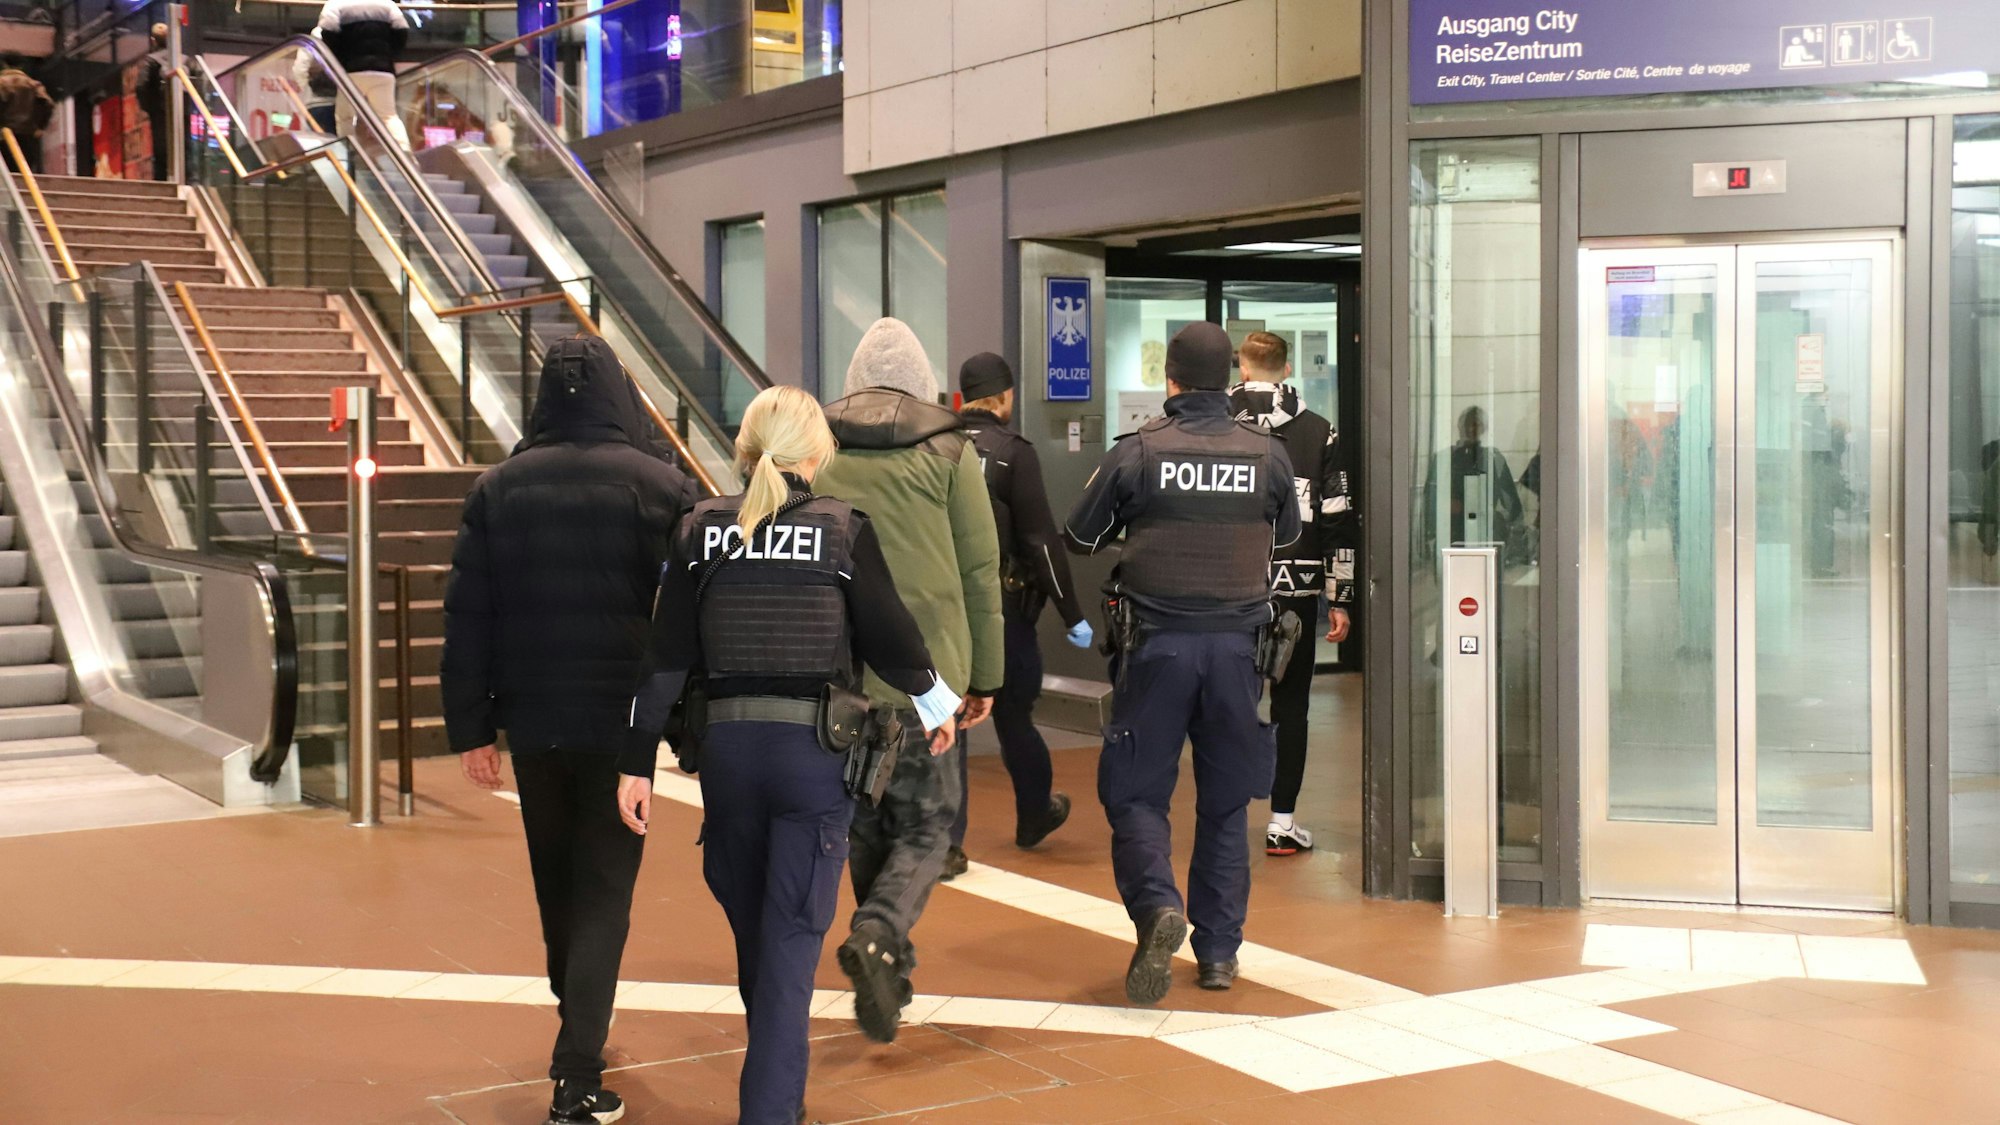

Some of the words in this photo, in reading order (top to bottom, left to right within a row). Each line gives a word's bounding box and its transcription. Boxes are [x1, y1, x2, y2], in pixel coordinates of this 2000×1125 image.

[1437, 14, 1529, 38] Ausgang
[1535, 10, 1578, 33] City
[1436, 40, 1582, 64] ReiseZentrum
[1437, 75, 1459, 87] Exit
[1461, 73, 1486, 88] City,
[1489, 72, 1523, 85] Travel
[1526, 70, 1565, 83] Center
[1566, 69, 1574, 82] /
[1575, 68, 1611, 81] Sortie
[1613, 66, 1639, 80] Cité,
[1643, 65, 1682, 78] Centre
[1689, 63, 1704, 76] de
[1707, 61, 1750, 77] voyage
[1049, 367, 1090, 380] POLIZEI
[1160, 461, 1256, 493] POLIZEI
[703, 524, 822, 561] POLIZEI
